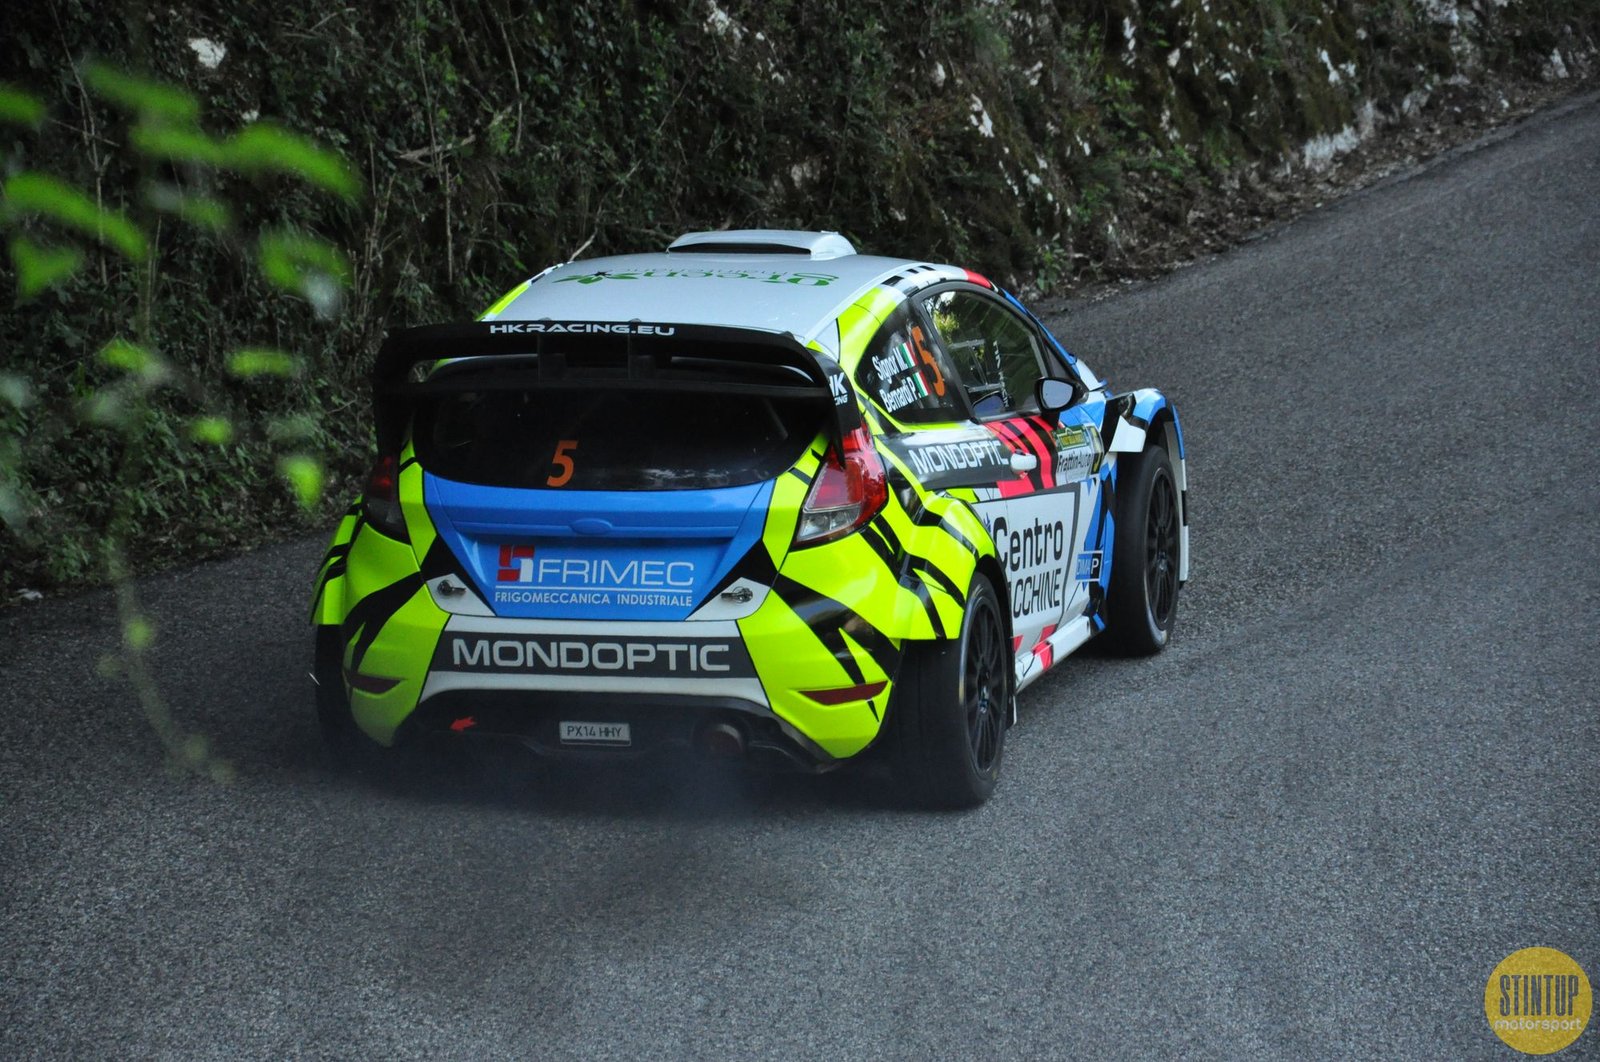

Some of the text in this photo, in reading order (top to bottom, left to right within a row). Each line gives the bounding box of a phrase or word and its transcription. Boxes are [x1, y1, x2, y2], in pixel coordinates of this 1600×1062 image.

[490, 323, 675, 336] HKRACING.EU
[911, 326, 945, 396] 5
[879, 379, 915, 413] Bernardi
[546, 440, 579, 488] 5
[908, 440, 1009, 475] MONDOPTIC
[993, 516, 1063, 572] Centro
[538, 559, 694, 586] FRIMEC
[495, 592, 693, 607] FRIGOMECCANICA INDUSTRIALE
[1008, 568, 1062, 618] CCHINE
[452, 638, 731, 671] MONDOPTIC
[567, 725, 596, 737] PX14
